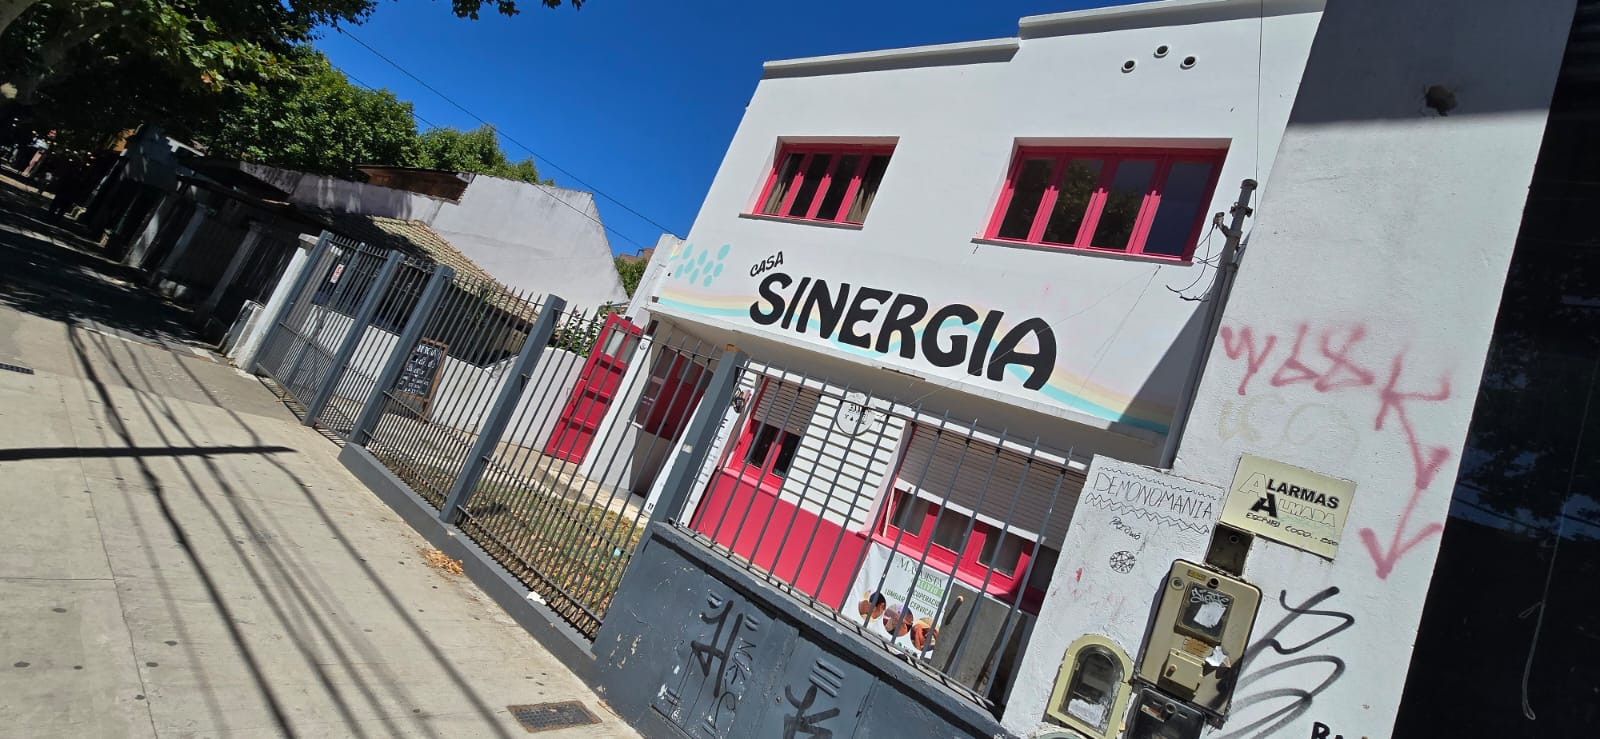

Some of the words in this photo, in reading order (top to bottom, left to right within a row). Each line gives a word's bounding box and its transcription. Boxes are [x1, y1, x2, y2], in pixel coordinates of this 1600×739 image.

[750, 251, 784, 277] CASA
[749, 272, 1057, 390] SINERGIA
[1094, 473, 1212, 519] DEMONOMANIA
[1239, 472, 1339, 509] ALARMAS
[1250, 492, 1335, 527] ALMADA
[896, 556, 942, 588] MAAJISTA
